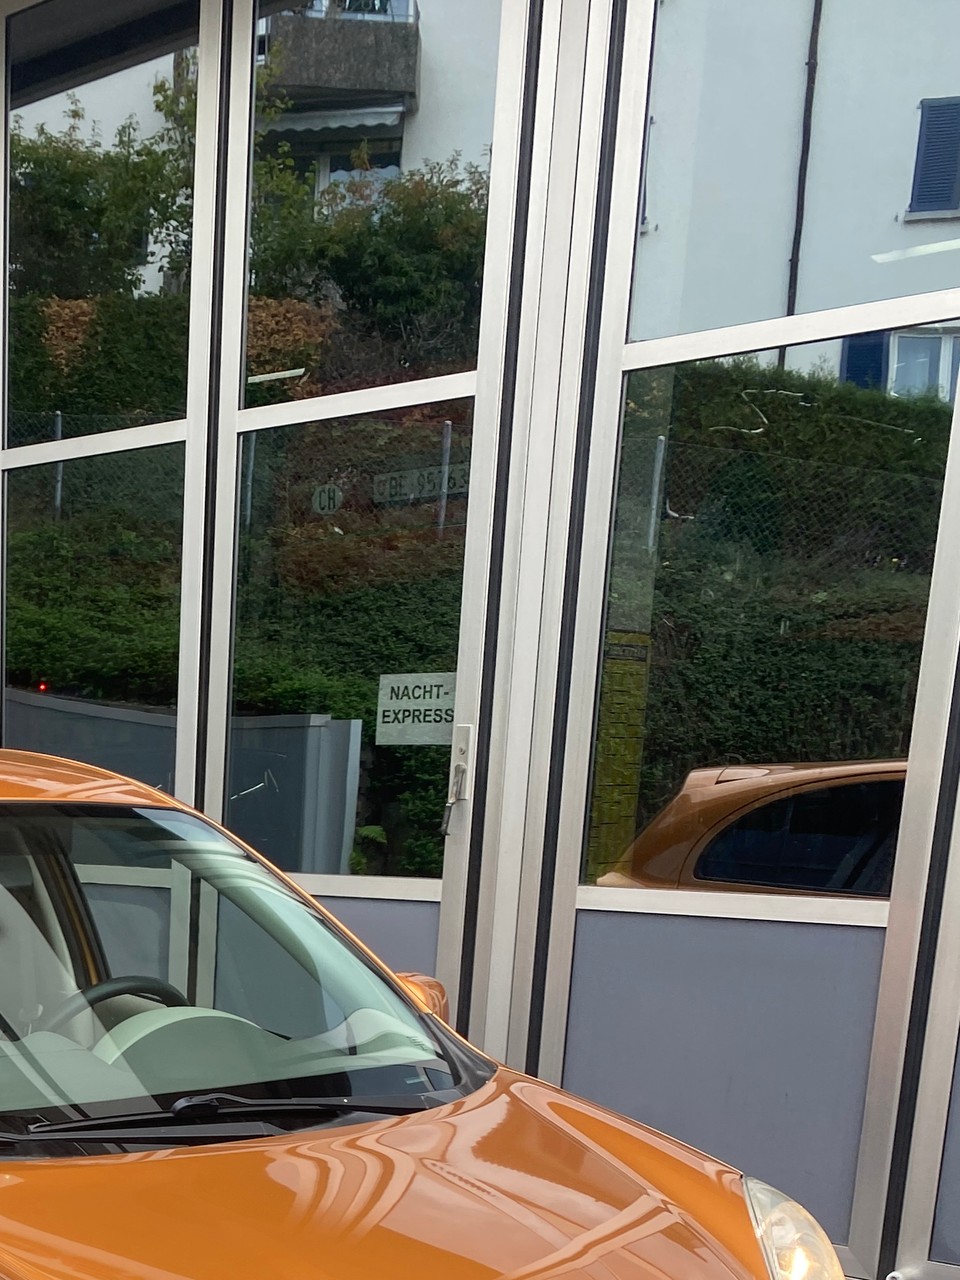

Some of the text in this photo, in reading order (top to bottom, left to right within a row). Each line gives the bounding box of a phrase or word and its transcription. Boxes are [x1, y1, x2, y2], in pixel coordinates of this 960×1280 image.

[318, 487, 336, 511] CH
[390, 684, 450, 700] NACHT-
[381, 708, 455, 724] EXPRESS
